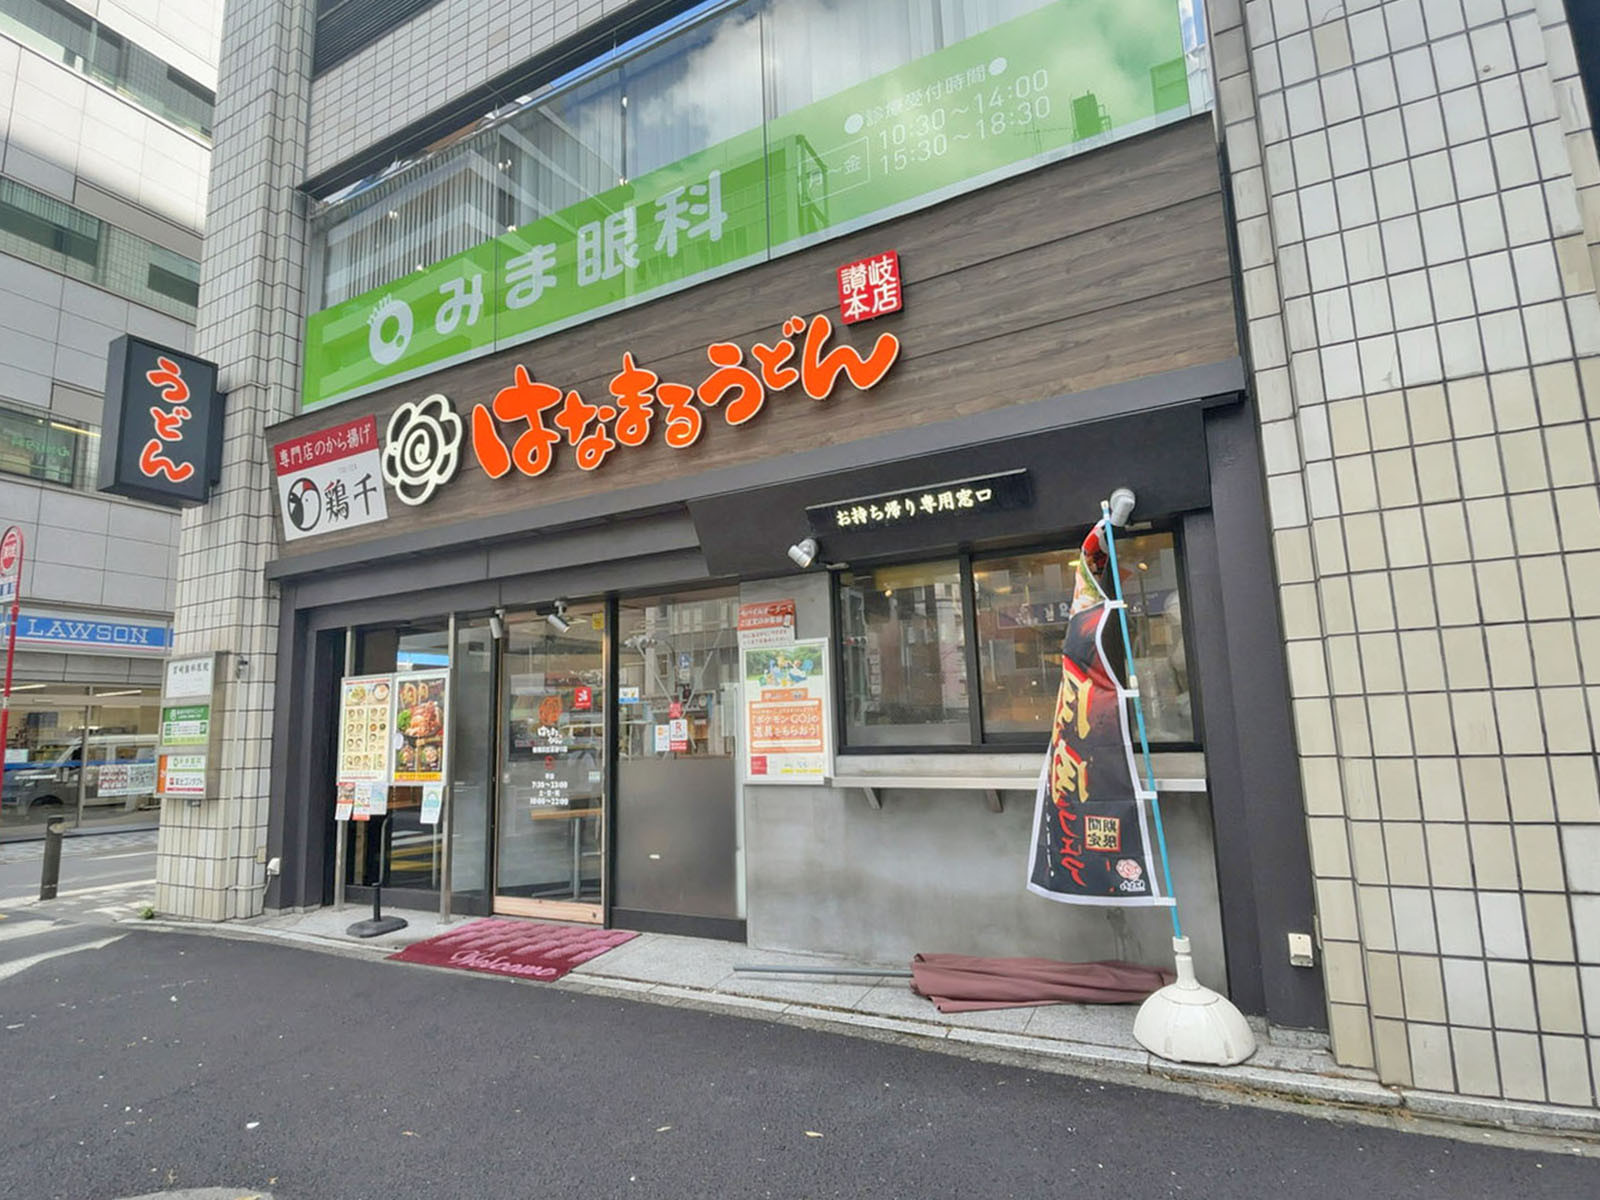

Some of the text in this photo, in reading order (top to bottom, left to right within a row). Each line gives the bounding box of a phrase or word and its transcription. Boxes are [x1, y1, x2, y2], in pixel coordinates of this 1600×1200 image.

[435, 170, 728, 334] みま眼科
[843, 283, 898, 321] 本店
[139, 356, 194, 482] うどん
[471, 313, 900, 479] はなまるうどん
[278, 422, 371, 469] 専門店のから揚げ
[324, 472, 378, 523] 鶏千
[835, 488, 993, 527] お持ち帰り専用窓口
[26, 618, 149, 644] LAWSON
[448, 949, 557, 977] Welcome
